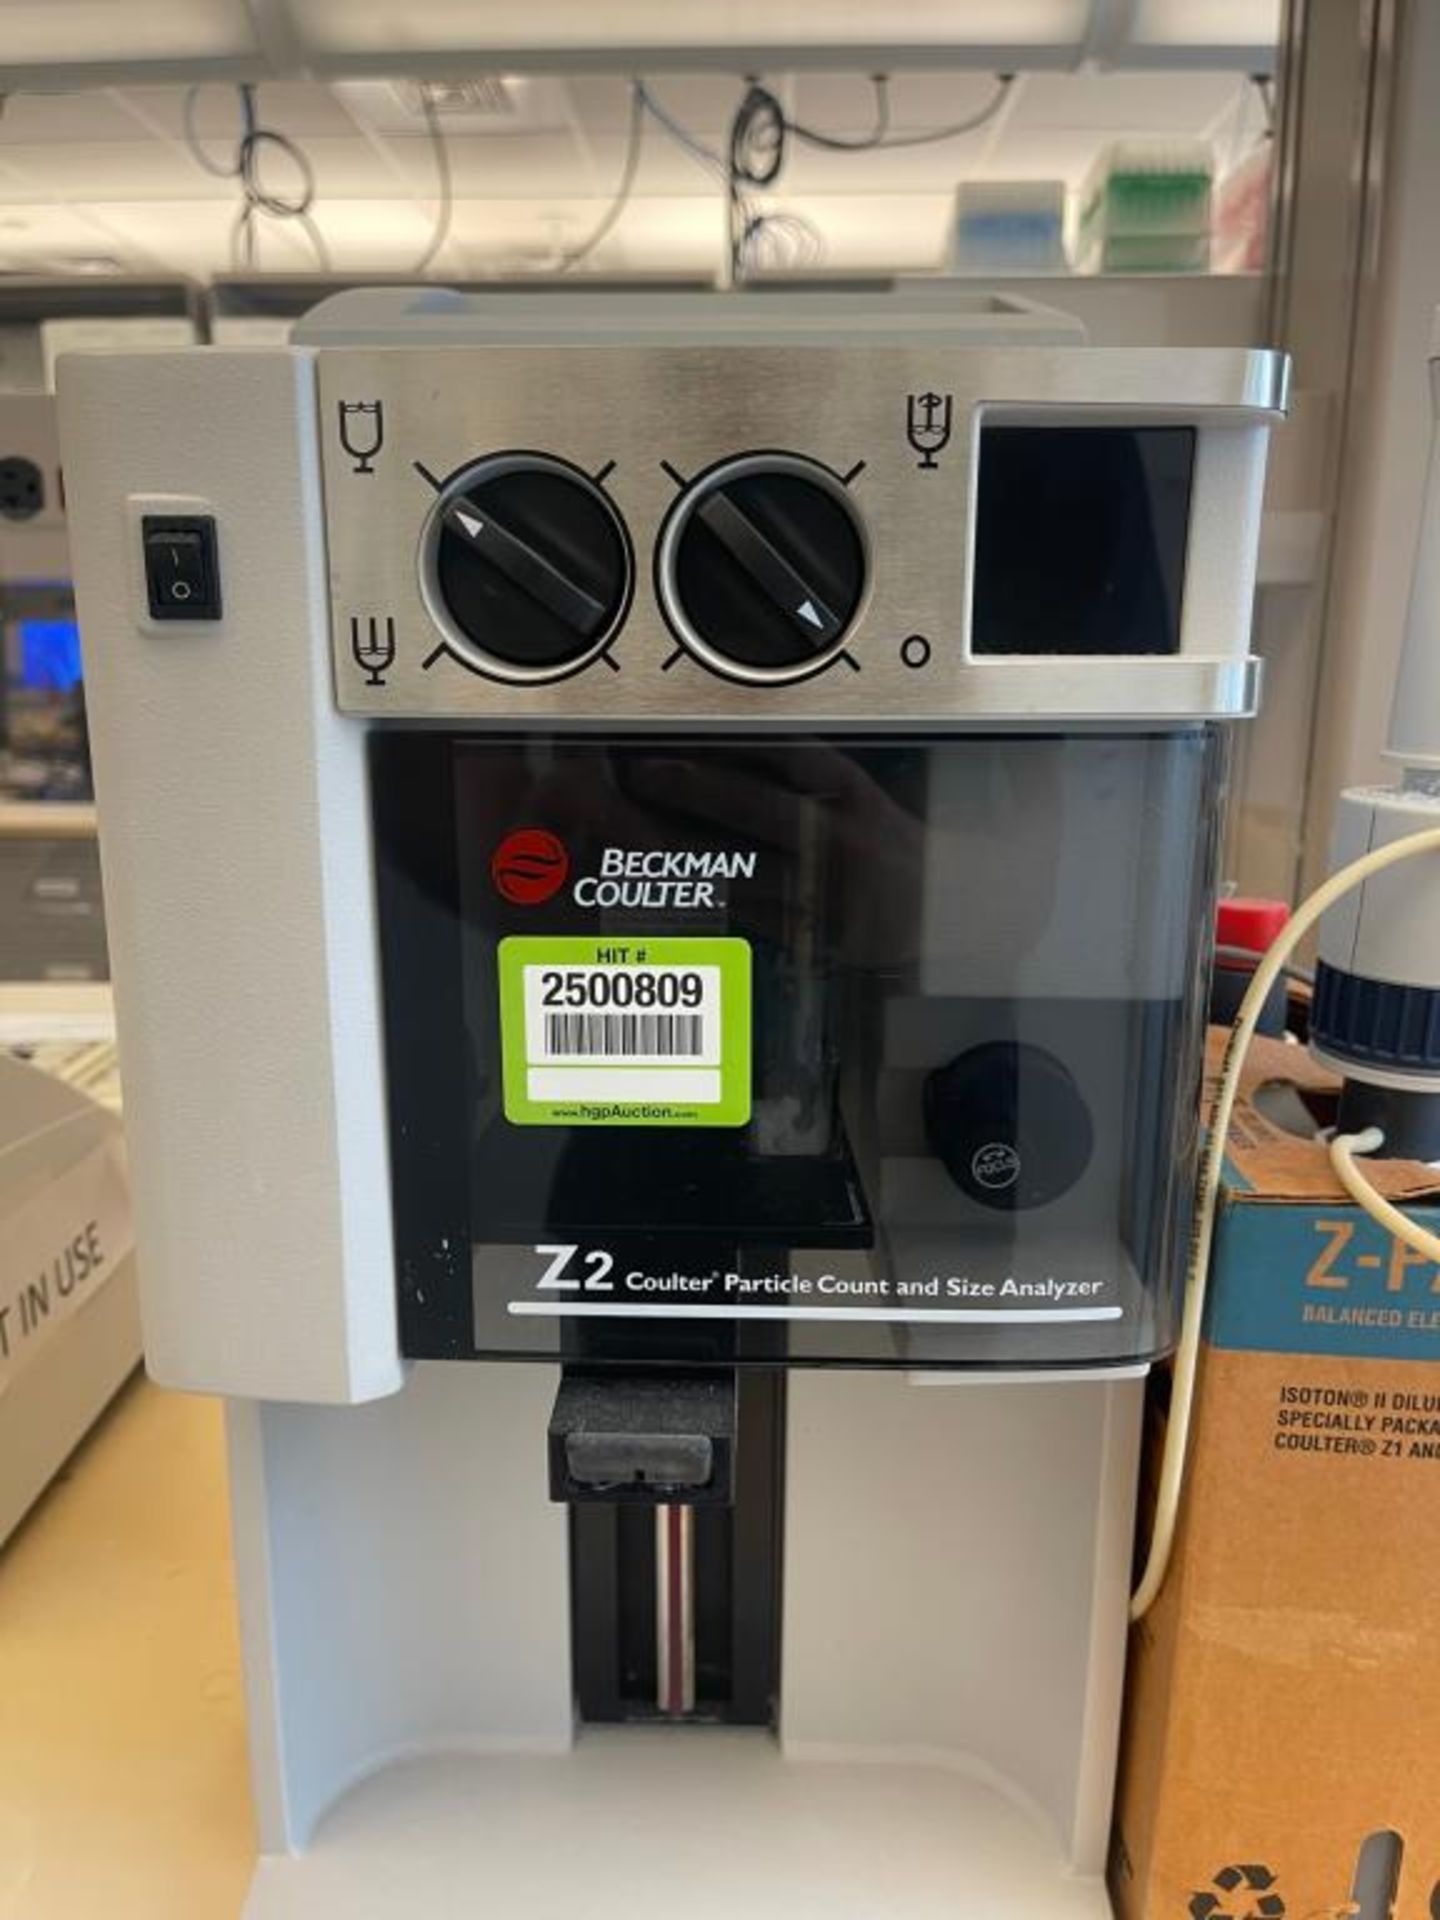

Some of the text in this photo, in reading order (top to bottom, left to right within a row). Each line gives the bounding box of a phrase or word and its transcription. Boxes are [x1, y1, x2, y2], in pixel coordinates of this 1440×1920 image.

[601, 849, 757, 878] BECKMAN
[597, 948, 647, 963] HIT #
[541, 972, 703, 1007] 2500809
[535, 1244, 614, 1290] Z2
[724, 1273, 812, 1294] Particle
[817, 1275, 889, 1295] Count
[897, 1277, 938, 1296] and
[947, 1277, 995, 1297] Size
[999, 1278, 1103, 1300] Analyzer
[1306, 1220, 1440, 1292] Z-P
[19, 1272, 49, 1336] IN
[55, 1220, 104, 1297] USE
[1303, 1304, 1401, 1327] BALANCED
[1277, 1409, 1376, 1431] SPECIALLY
